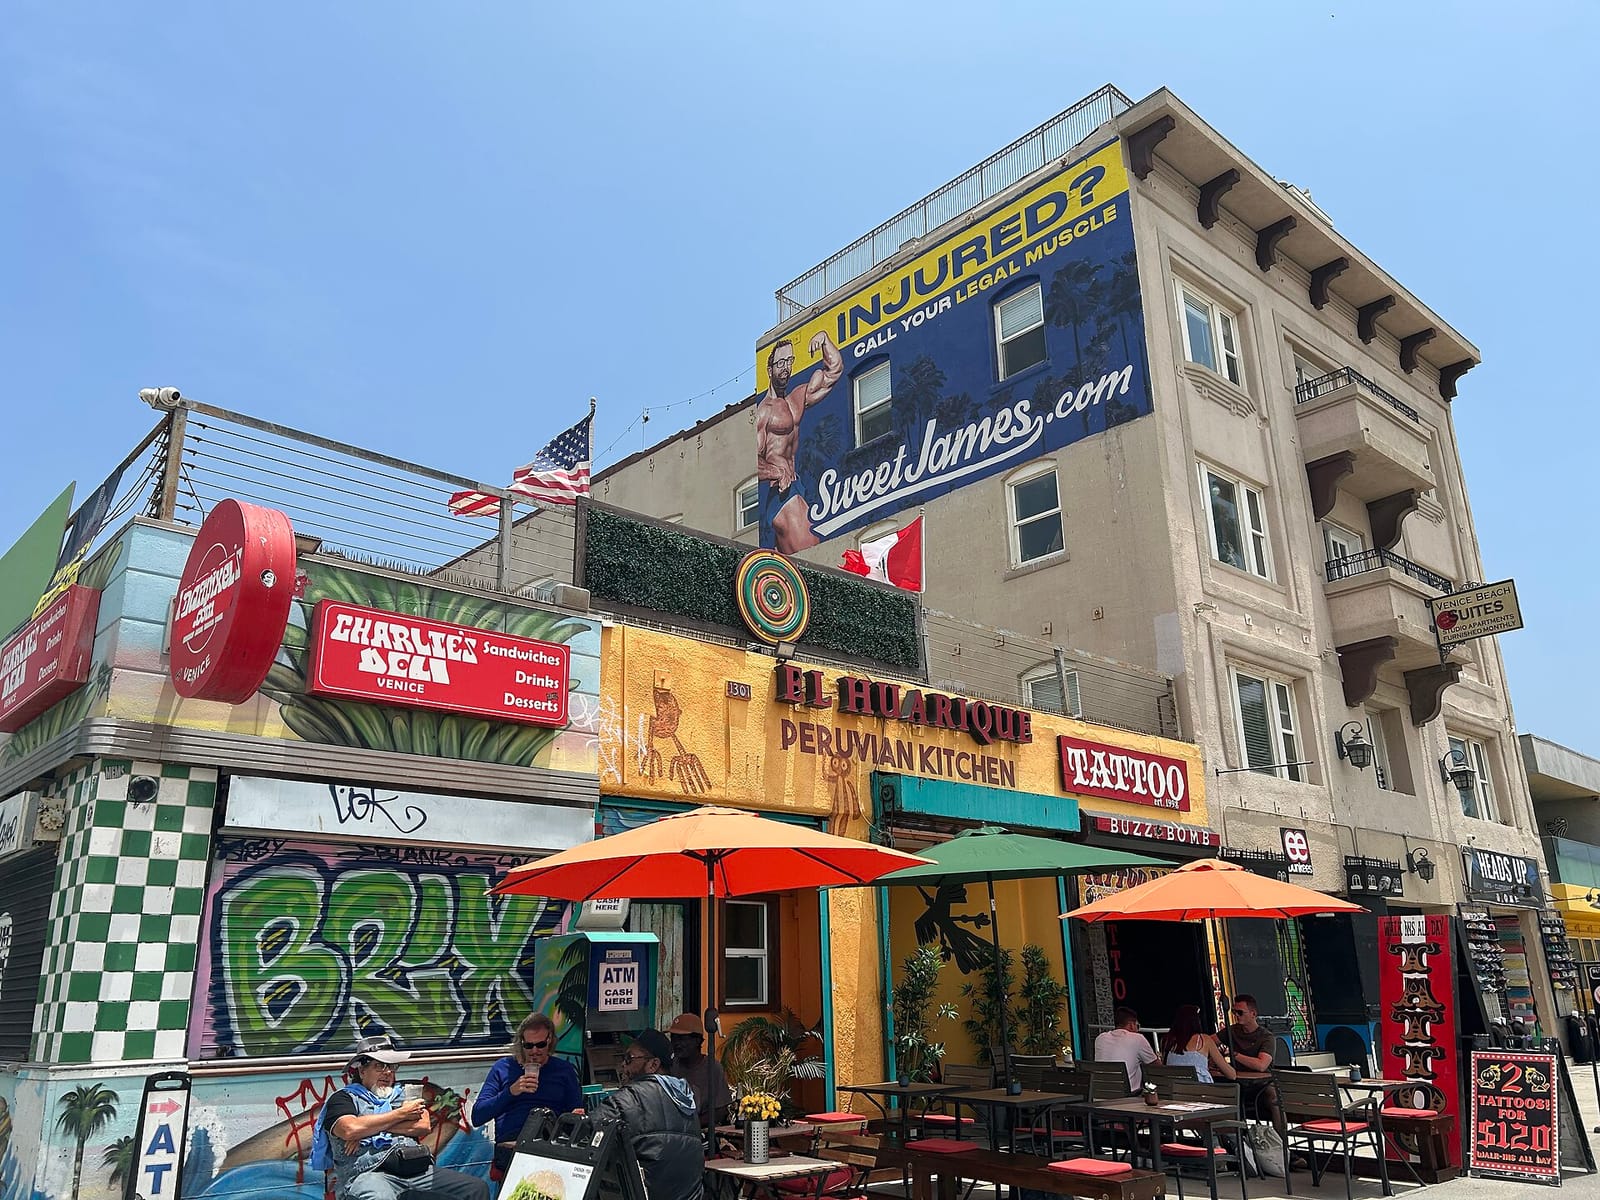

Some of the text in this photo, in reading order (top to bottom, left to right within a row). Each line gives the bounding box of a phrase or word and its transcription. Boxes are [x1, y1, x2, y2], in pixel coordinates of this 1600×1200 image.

[837, 165, 1106, 343] INJURED?
[854, 204, 1118, 358] CALL YOUR LEGAL MUSCLE
[1436, 586, 1511, 610] VENICE BEACH
[1450, 600, 1504, 621] SUITES
[1442, 614, 1515, 636] STUDIO APARTMENTS
[1443, 619, 1517, 642] FURNISHED MONTHLY
[330, 613, 561, 667] CHARLIE'S Sandwiches
[183, 653, 211, 683] VENICE
[358, 647, 450, 685] DELI
[377, 670, 560, 694] VENICE Drinks
[728, 682, 751, 699] 1301
[504, 692, 559, 713] Desserts
[776, 664, 1033, 746] EL HUARIQUE
[780, 718, 1016, 788] PERUVIAN KITCHEN
[1066, 746, 1185, 802] TATTOO
[1110, 817, 1210, 845] BUZZ BOMB
[1477, 851, 1527, 885] HEADS UP
[1431, 919, 1445, 937] DAY
[603, 967, 635, 984] ATM
[604, 989, 633, 997] CASH
[604, 998, 633, 1006] HERE
[1501, 1062, 1523, 1094] 2
[1477, 1094, 1551, 1112] TATTOOS!
[1498, 1108, 1527, 1121] FOR
[1477, 1119, 1552, 1152] $120
[1519, 1154, 1534, 1164] ALL
[1536, 1153, 1552, 1165] DAY
